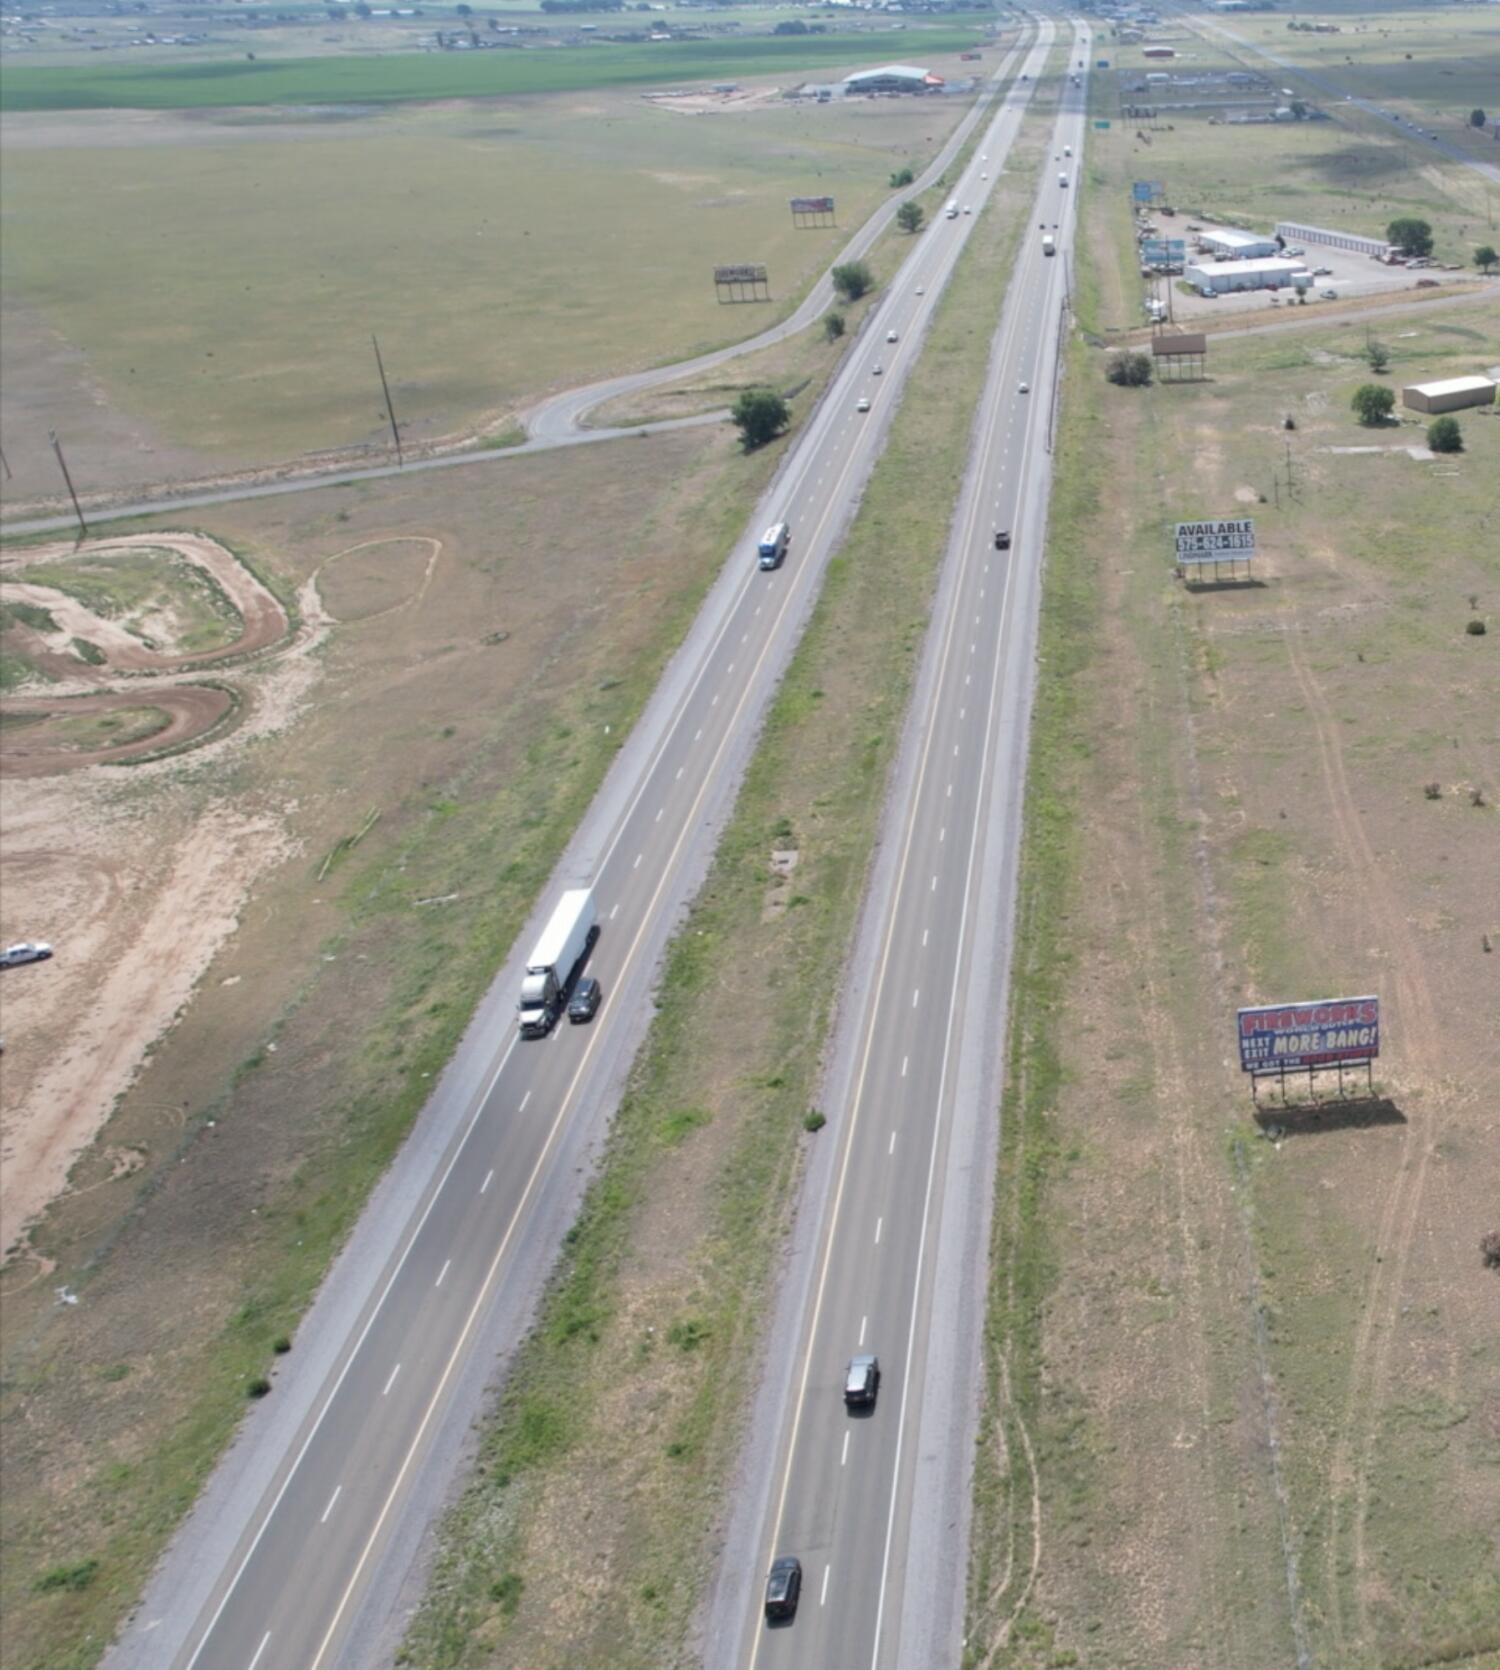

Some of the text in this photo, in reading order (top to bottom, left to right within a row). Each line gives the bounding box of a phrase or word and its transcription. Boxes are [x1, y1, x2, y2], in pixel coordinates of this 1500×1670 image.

[1179, 522, 1252, 536] AVAILABLE
[1241, 1002, 1377, 1036] FIREWORKS
[1242, 1037, 1270, 1049] NEXT
[1274, 1027, 1377, 1054] MORE BANG!
[1244, 1048, 1269, 1059] EXIT
